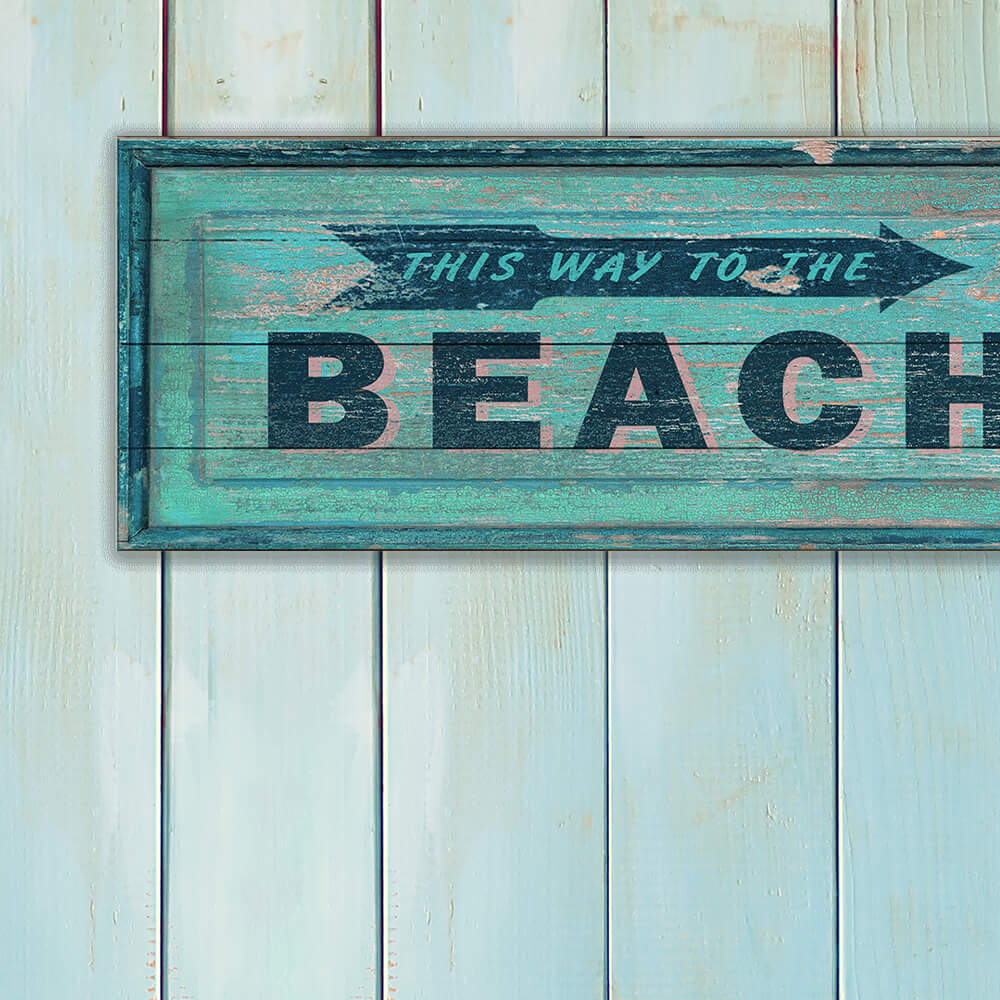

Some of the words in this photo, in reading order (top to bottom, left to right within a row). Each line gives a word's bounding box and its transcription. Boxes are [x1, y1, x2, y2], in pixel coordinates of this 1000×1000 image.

[402, 251, 525, 282] THIS
[549, 251, 662, 282] WAY
[689, 251, 748, 282] TO
[780, 251, 876, 282] THE
